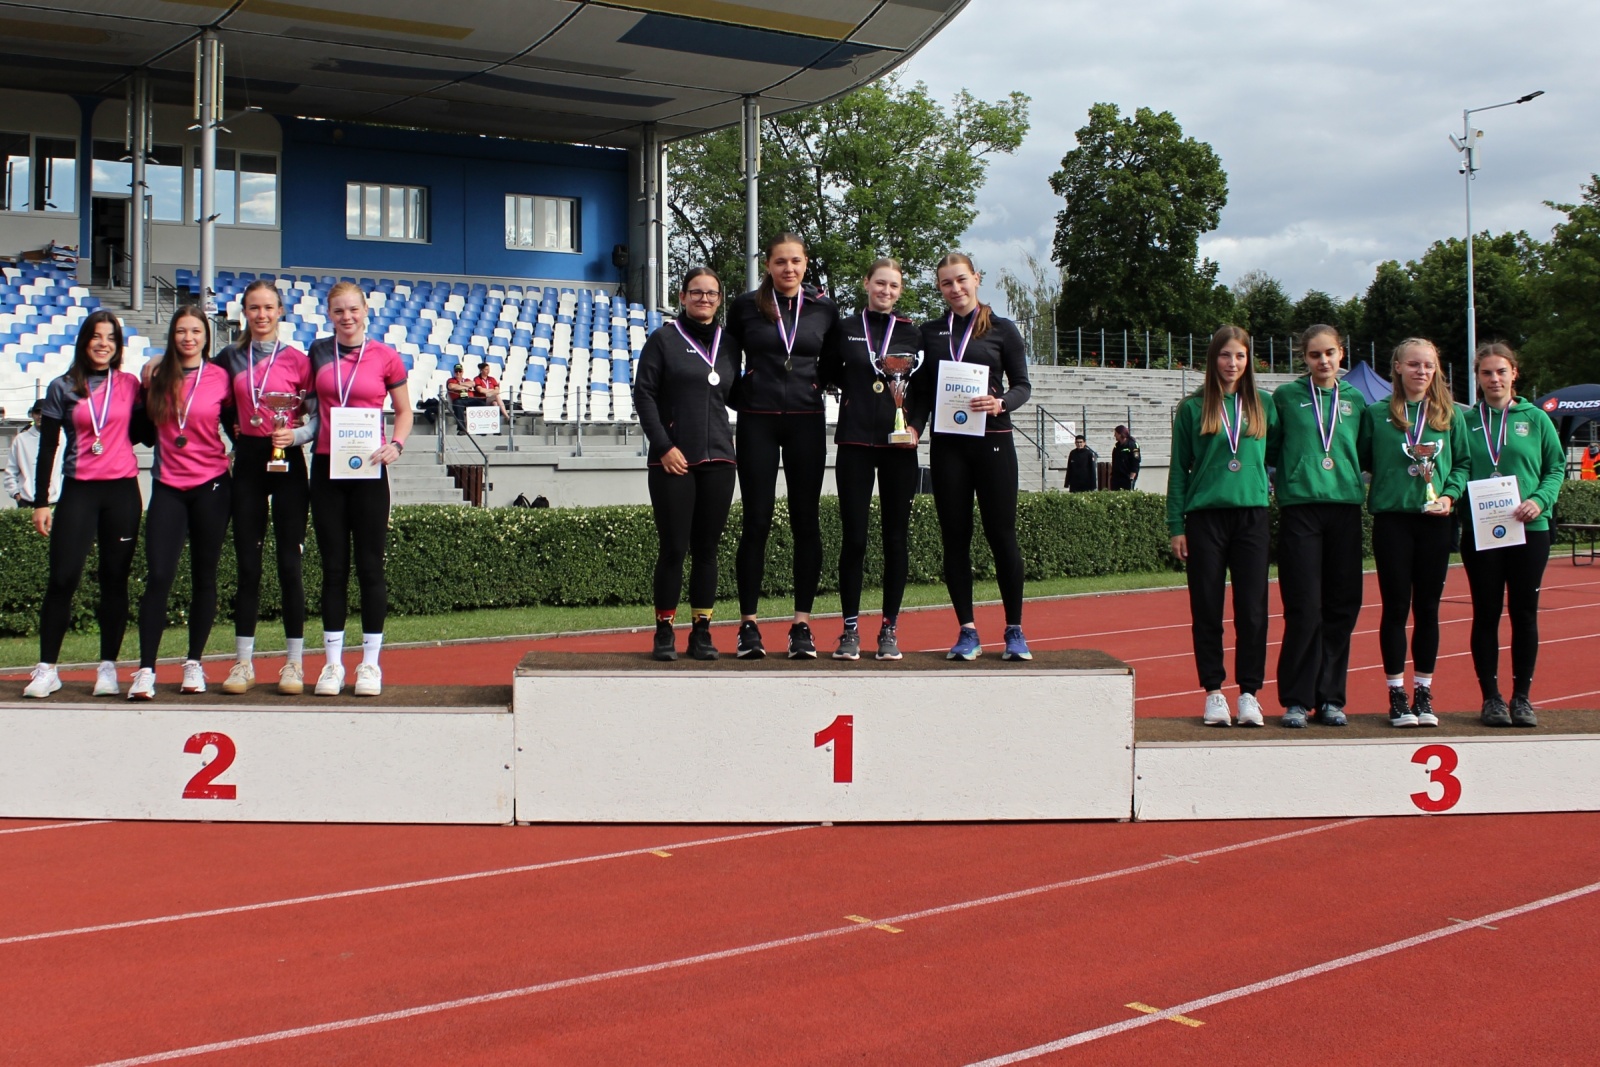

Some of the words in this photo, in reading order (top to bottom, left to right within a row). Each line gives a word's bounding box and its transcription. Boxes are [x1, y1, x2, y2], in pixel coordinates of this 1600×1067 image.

[945, 383, 980, 394] DIPLOM
[1558, 400, 1600, 408] PROIZS
[338, 430, 373, 438] DIPLOM
[1478, 498, 1514, 511] DIPLOM
[814, 714, 853, 783] 1
[182, 731, 237, 800] 2
[1410, 744, 1462, 812] 3
